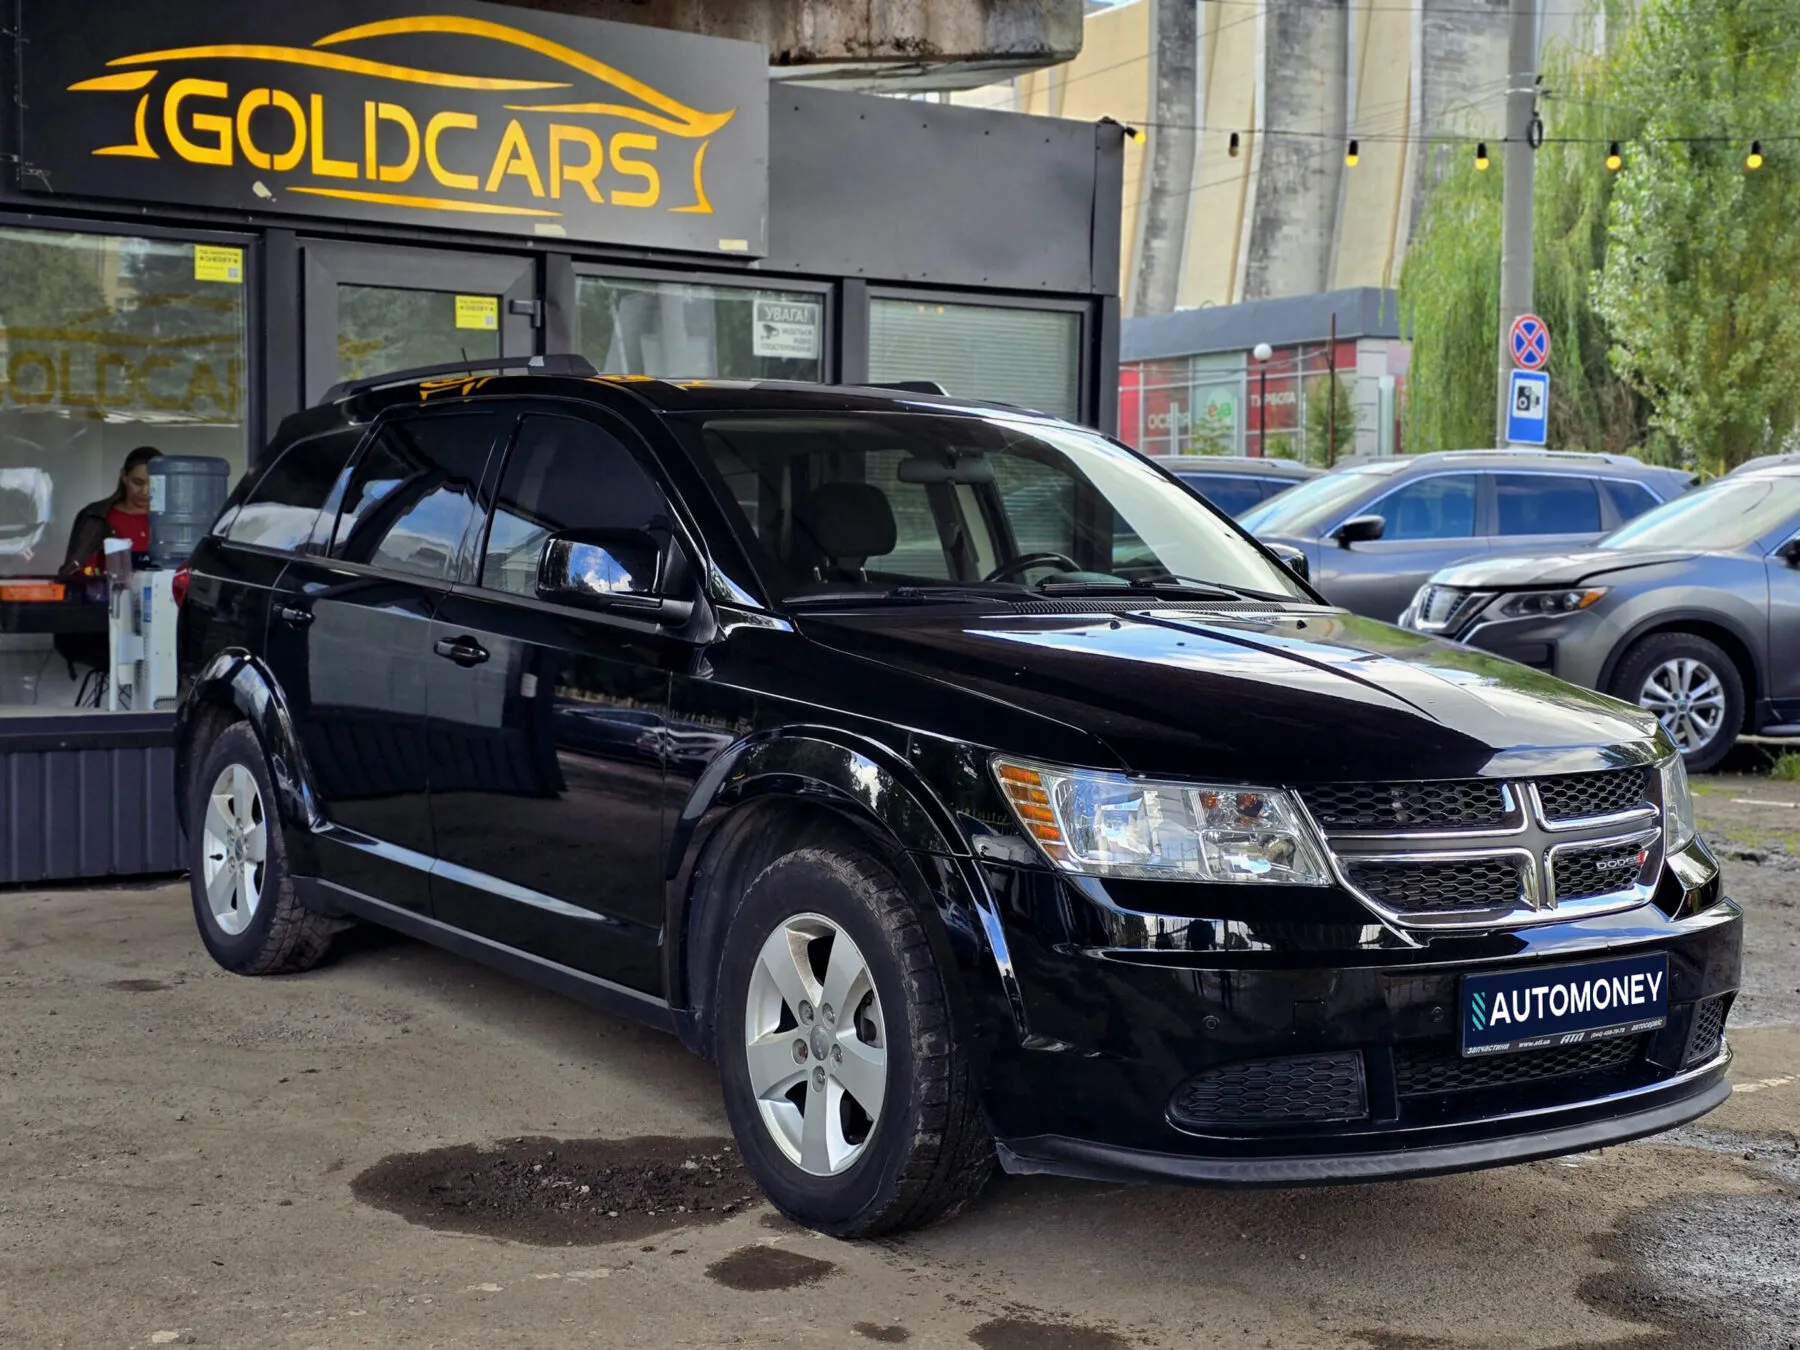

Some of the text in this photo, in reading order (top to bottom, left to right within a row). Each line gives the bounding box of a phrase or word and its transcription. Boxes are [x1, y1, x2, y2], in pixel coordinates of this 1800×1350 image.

[163, 77, 661, 209] GOLDCARS
[764, 306, 808, 323] УВАГА!
[1596, 855, 1640, 870] DODGE
[1489, 971, 1663, 1027] AUTOMONEY
